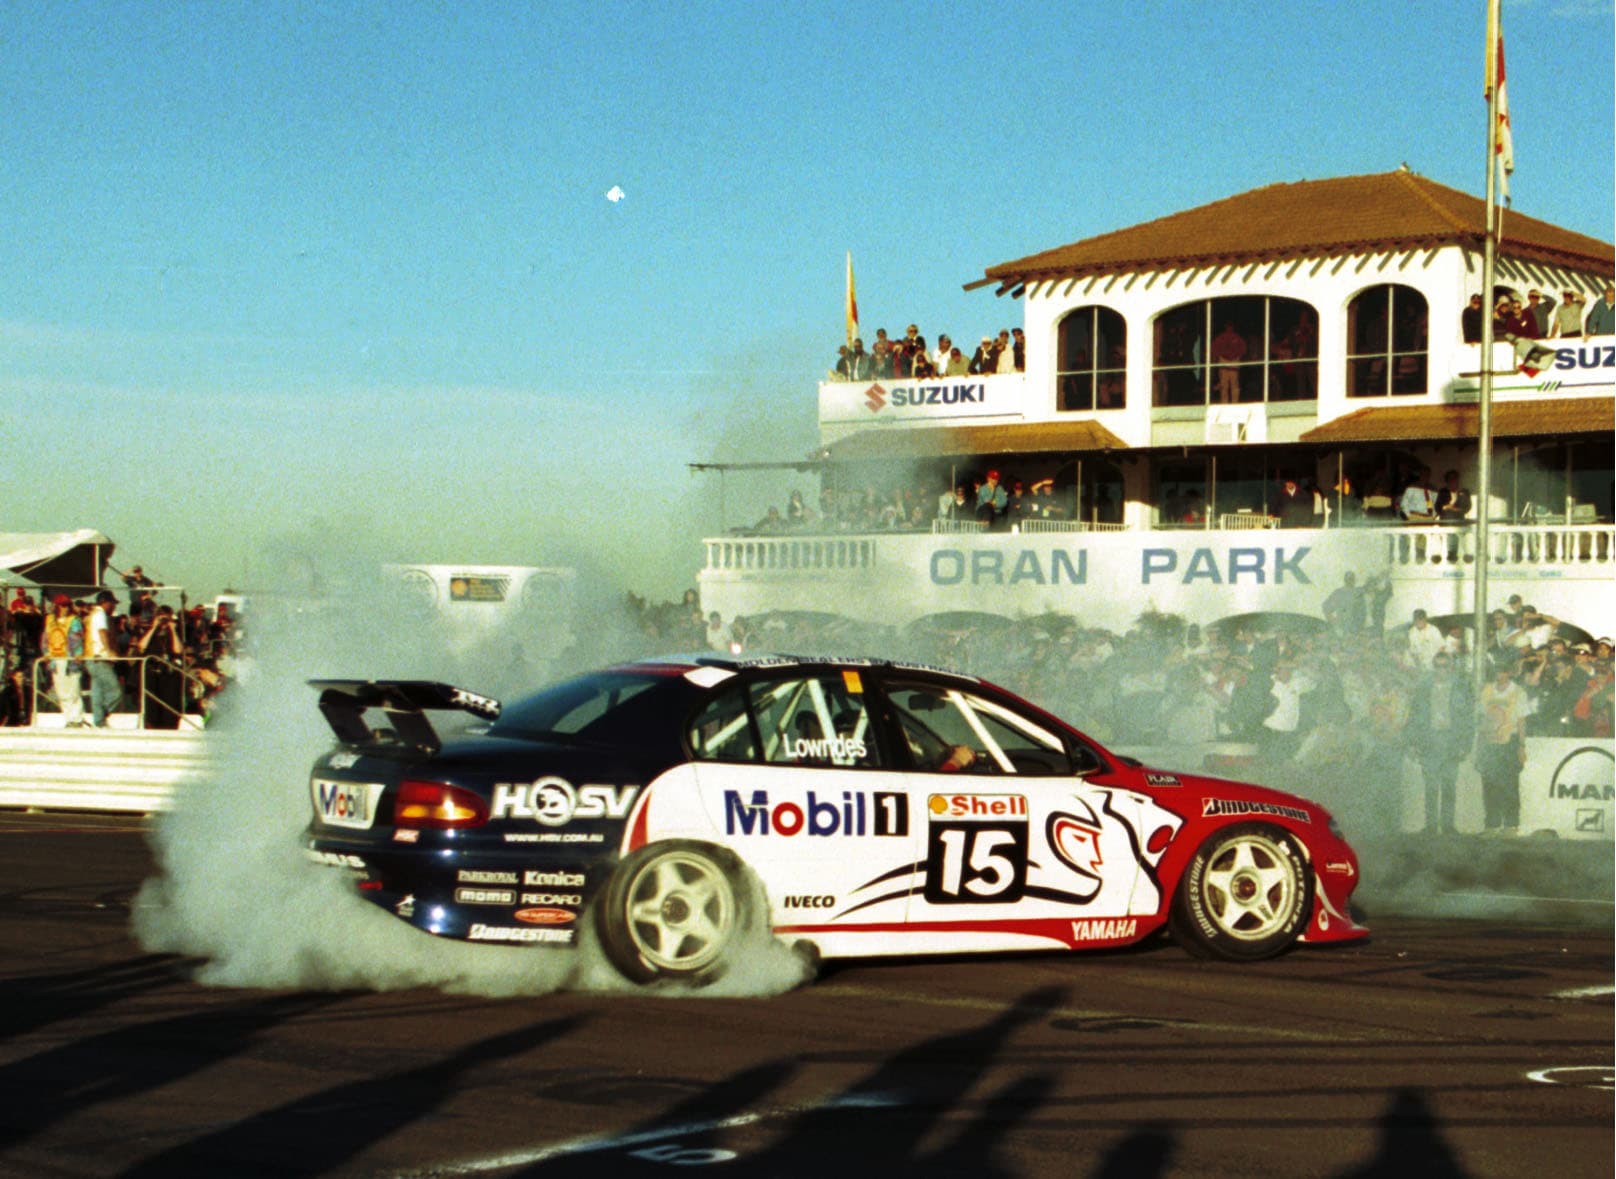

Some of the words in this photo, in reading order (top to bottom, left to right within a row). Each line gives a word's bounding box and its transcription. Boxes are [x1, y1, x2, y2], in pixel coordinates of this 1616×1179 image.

[891, 384, 985, 406] SUZUKI
[930, 549, 1088, 585] ORAN
[1141, 547, 1312, 585] PARK
[782, 733, 867, 758] Lowndes
[724, 789, 866, 837] Mobil
[877, 793, 902, 836] 1
[951, 795, 1026, 816] Shell
[1203, 798, 1310, 823] BRIDGESTONE
[939, 829, 1016, 896] 15
[524, 871, 585, 886] Konica
[460, 890, 512, 902] momo
[521, 893, 582, 905] RECARO
[784, 895, 836, 908] IVECO
[468, 923, 574, 943] BRIDGESTONE
[1071, 919, 1137, 941] YAMAHA
